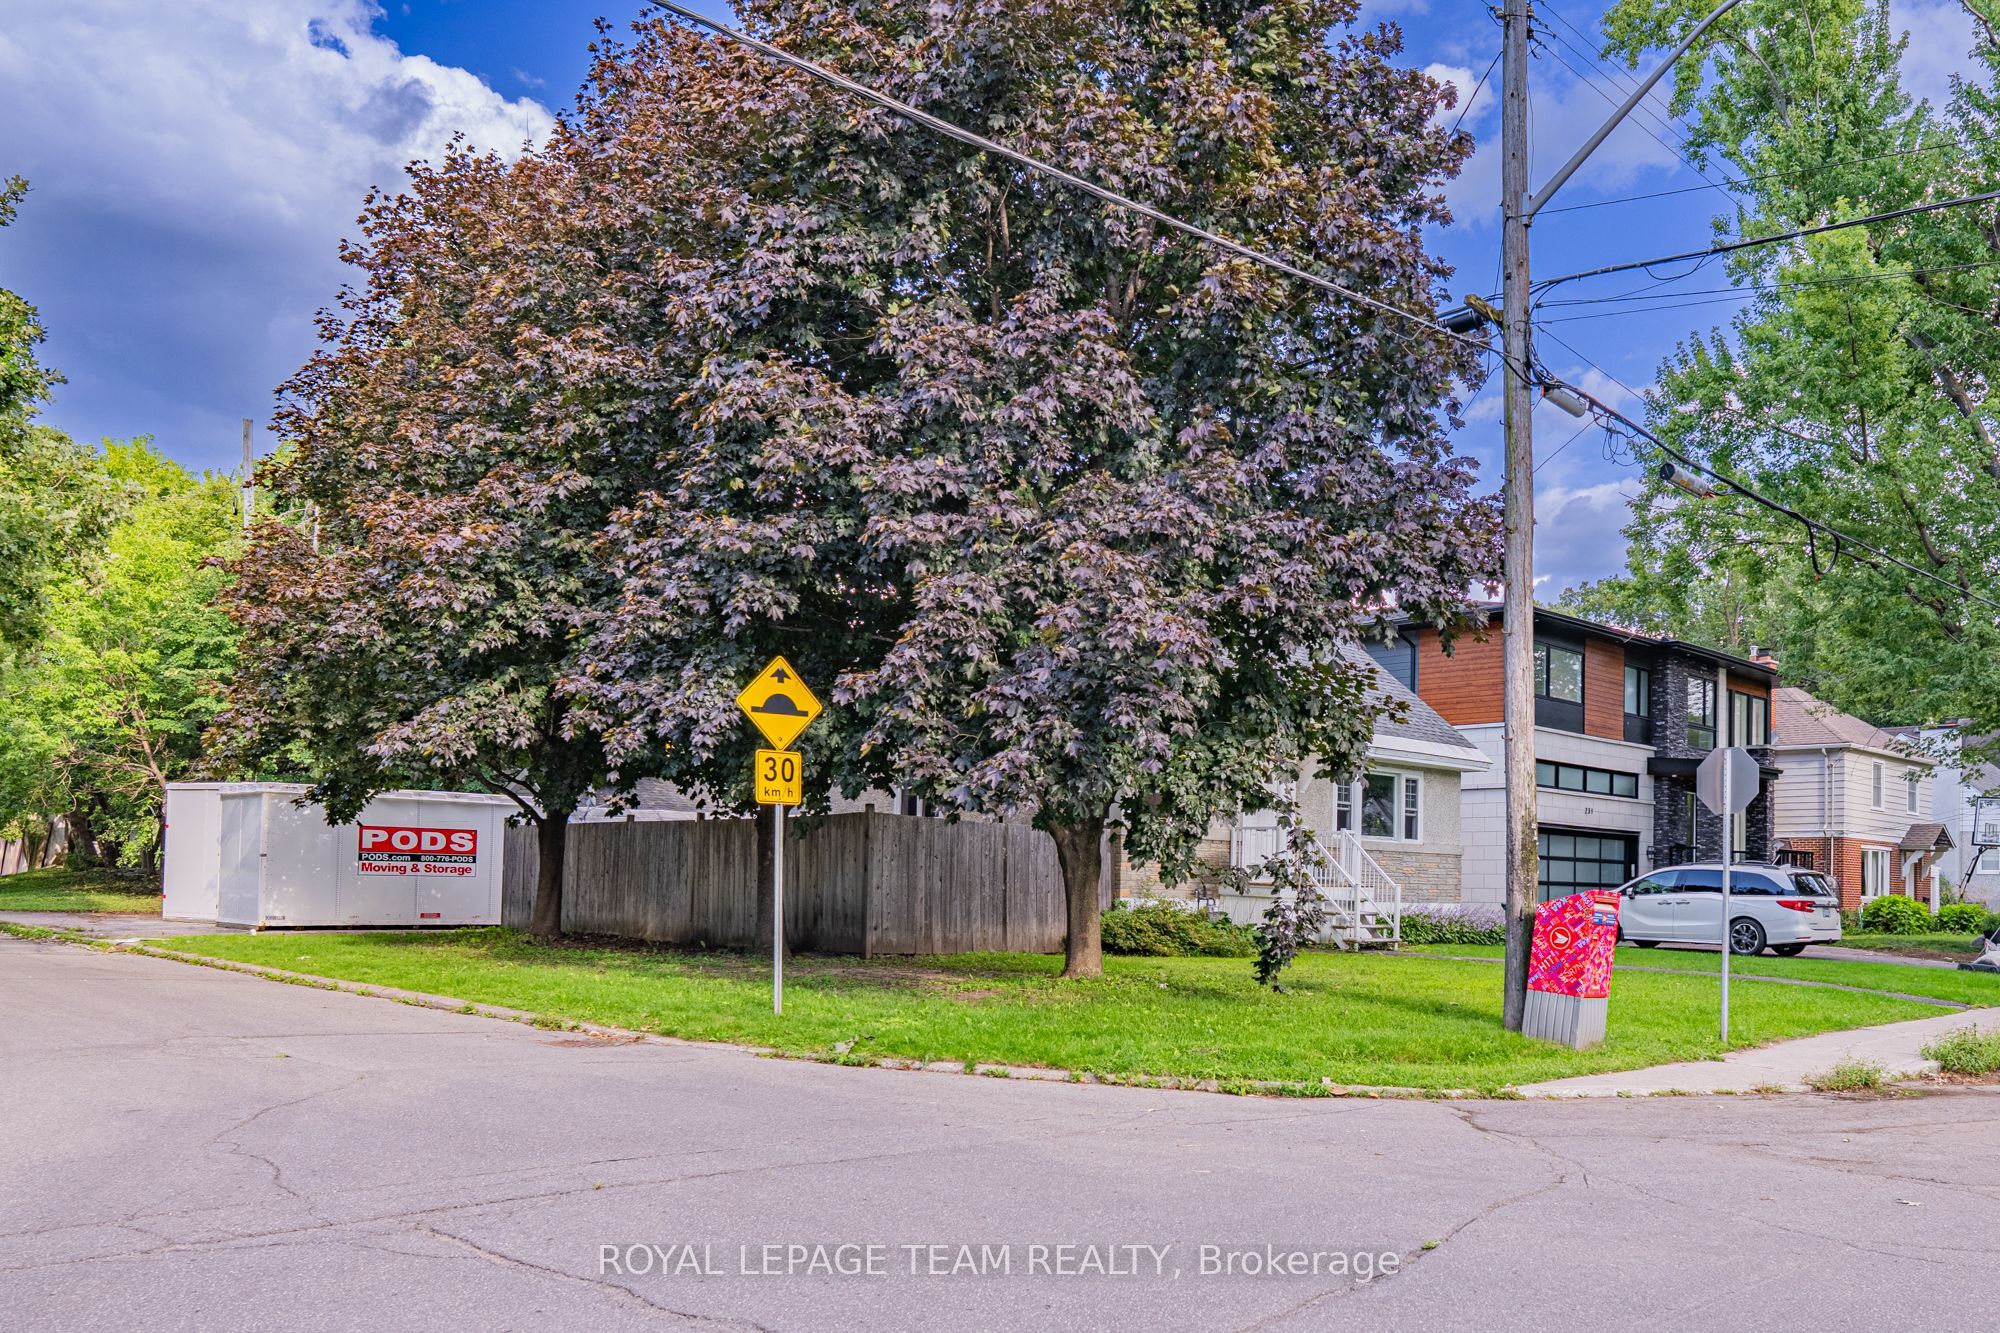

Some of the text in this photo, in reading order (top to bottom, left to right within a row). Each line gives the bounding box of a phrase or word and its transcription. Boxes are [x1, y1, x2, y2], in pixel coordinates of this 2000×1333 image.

[764, 757, 795, 783] 30
[361, 829, 474, 851] PODS
[361, 863, 472, 875] Moving & Storage
